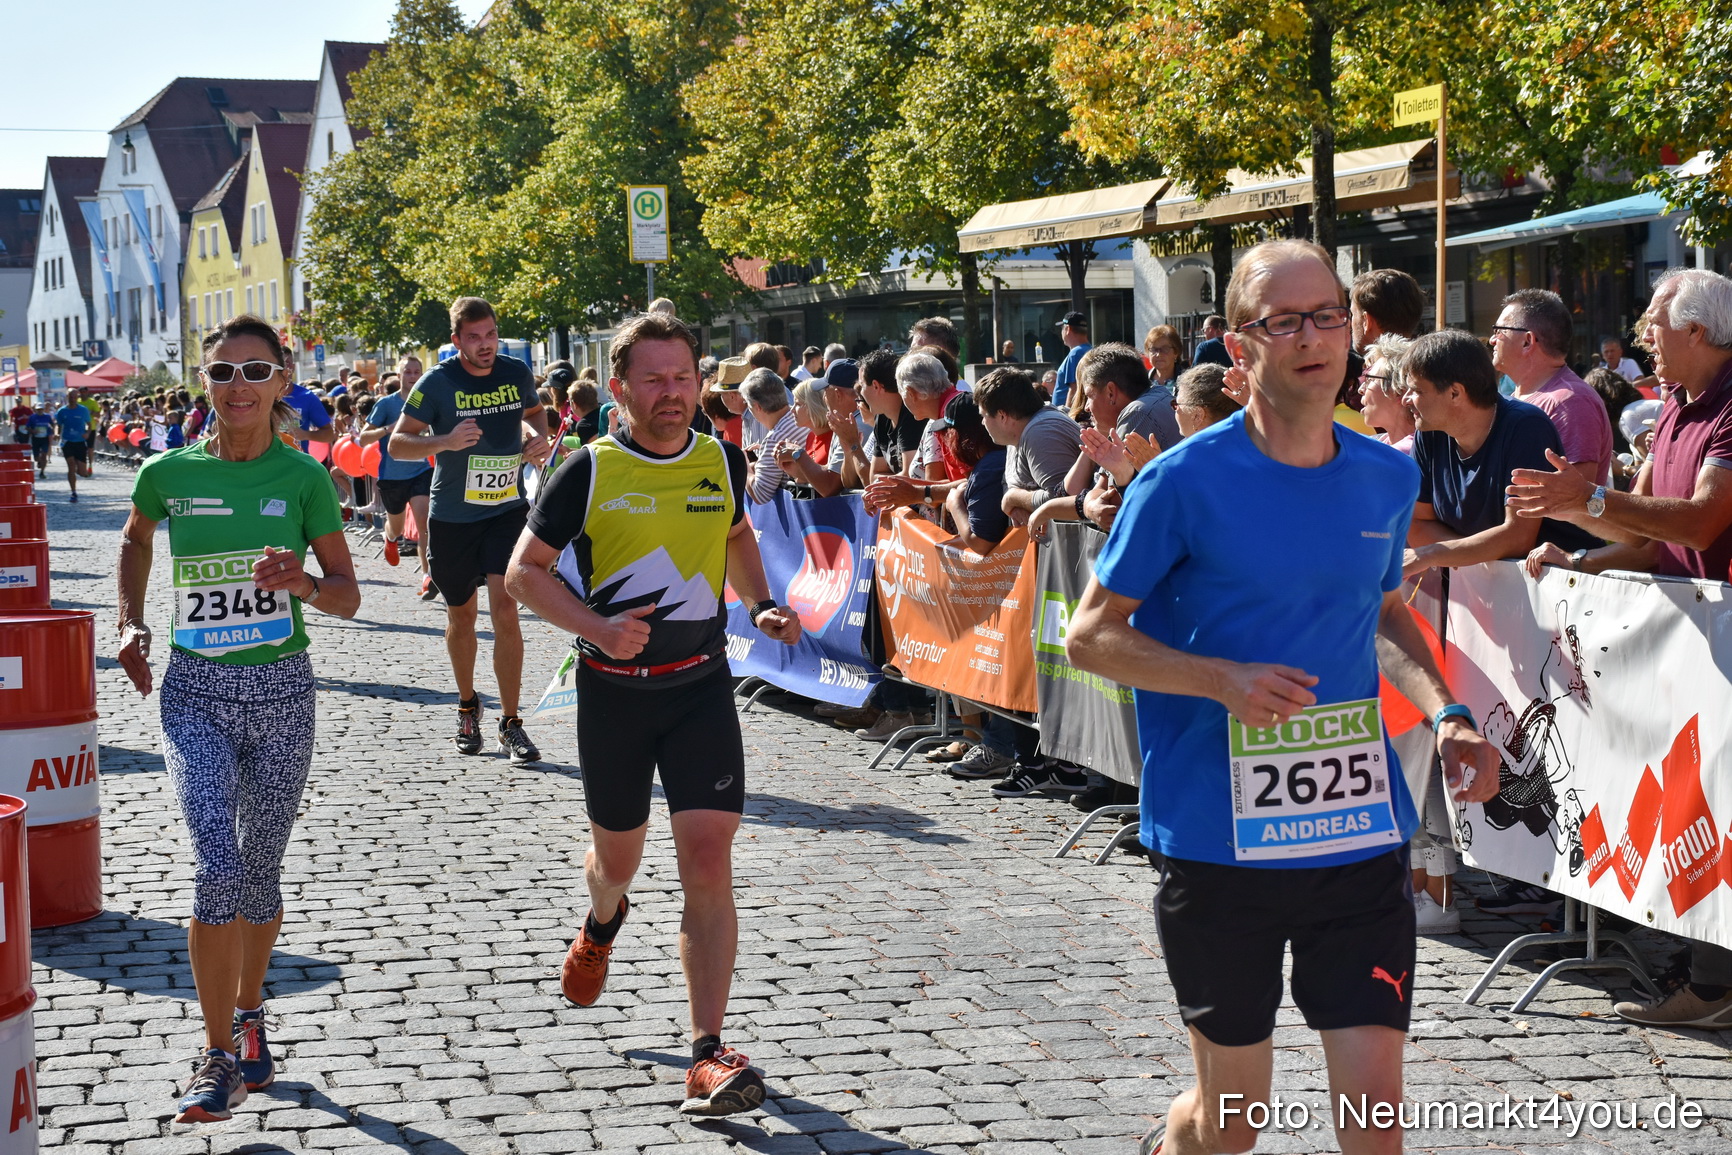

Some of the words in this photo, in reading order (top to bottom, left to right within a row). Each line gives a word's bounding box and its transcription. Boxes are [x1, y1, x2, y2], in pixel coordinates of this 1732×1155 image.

[1402, 98, 1439, 115] Toiletten
[454, 384, 521, 410] CrossFit
[456, 409, 482, 417] FORGING
[482, 407, 499, 415] ELITE
[500, 402, 522, 412] FITNESS
[474, 457, 518, 468] BOCK
[474, 470, 515, 489] 1202
[478, 491, 508, 500] STEFAN
[686, 504, 726, 513] Runners
[628, 506, 657, 514] MARX
[907, 548, 926, 578] CODE
[905, 576, 937, 607] CLINIC
[187, 587, 278, 623] 2348
[204, 627, 263, 645] MARIA
[900, 633, 947, 664] Agentur
[819, 657, 837, 684] GET
[1244, 710, 1367, 749] BOCK
[26, 744, 97, 793] AVIA
[1252, 752, 1373, 808] 2625
[1261, 811, 1372, 842] ANDREAS
[1659, 815, 1716, 886] Braun
[1686, 866, 1704, 885] Sicher
